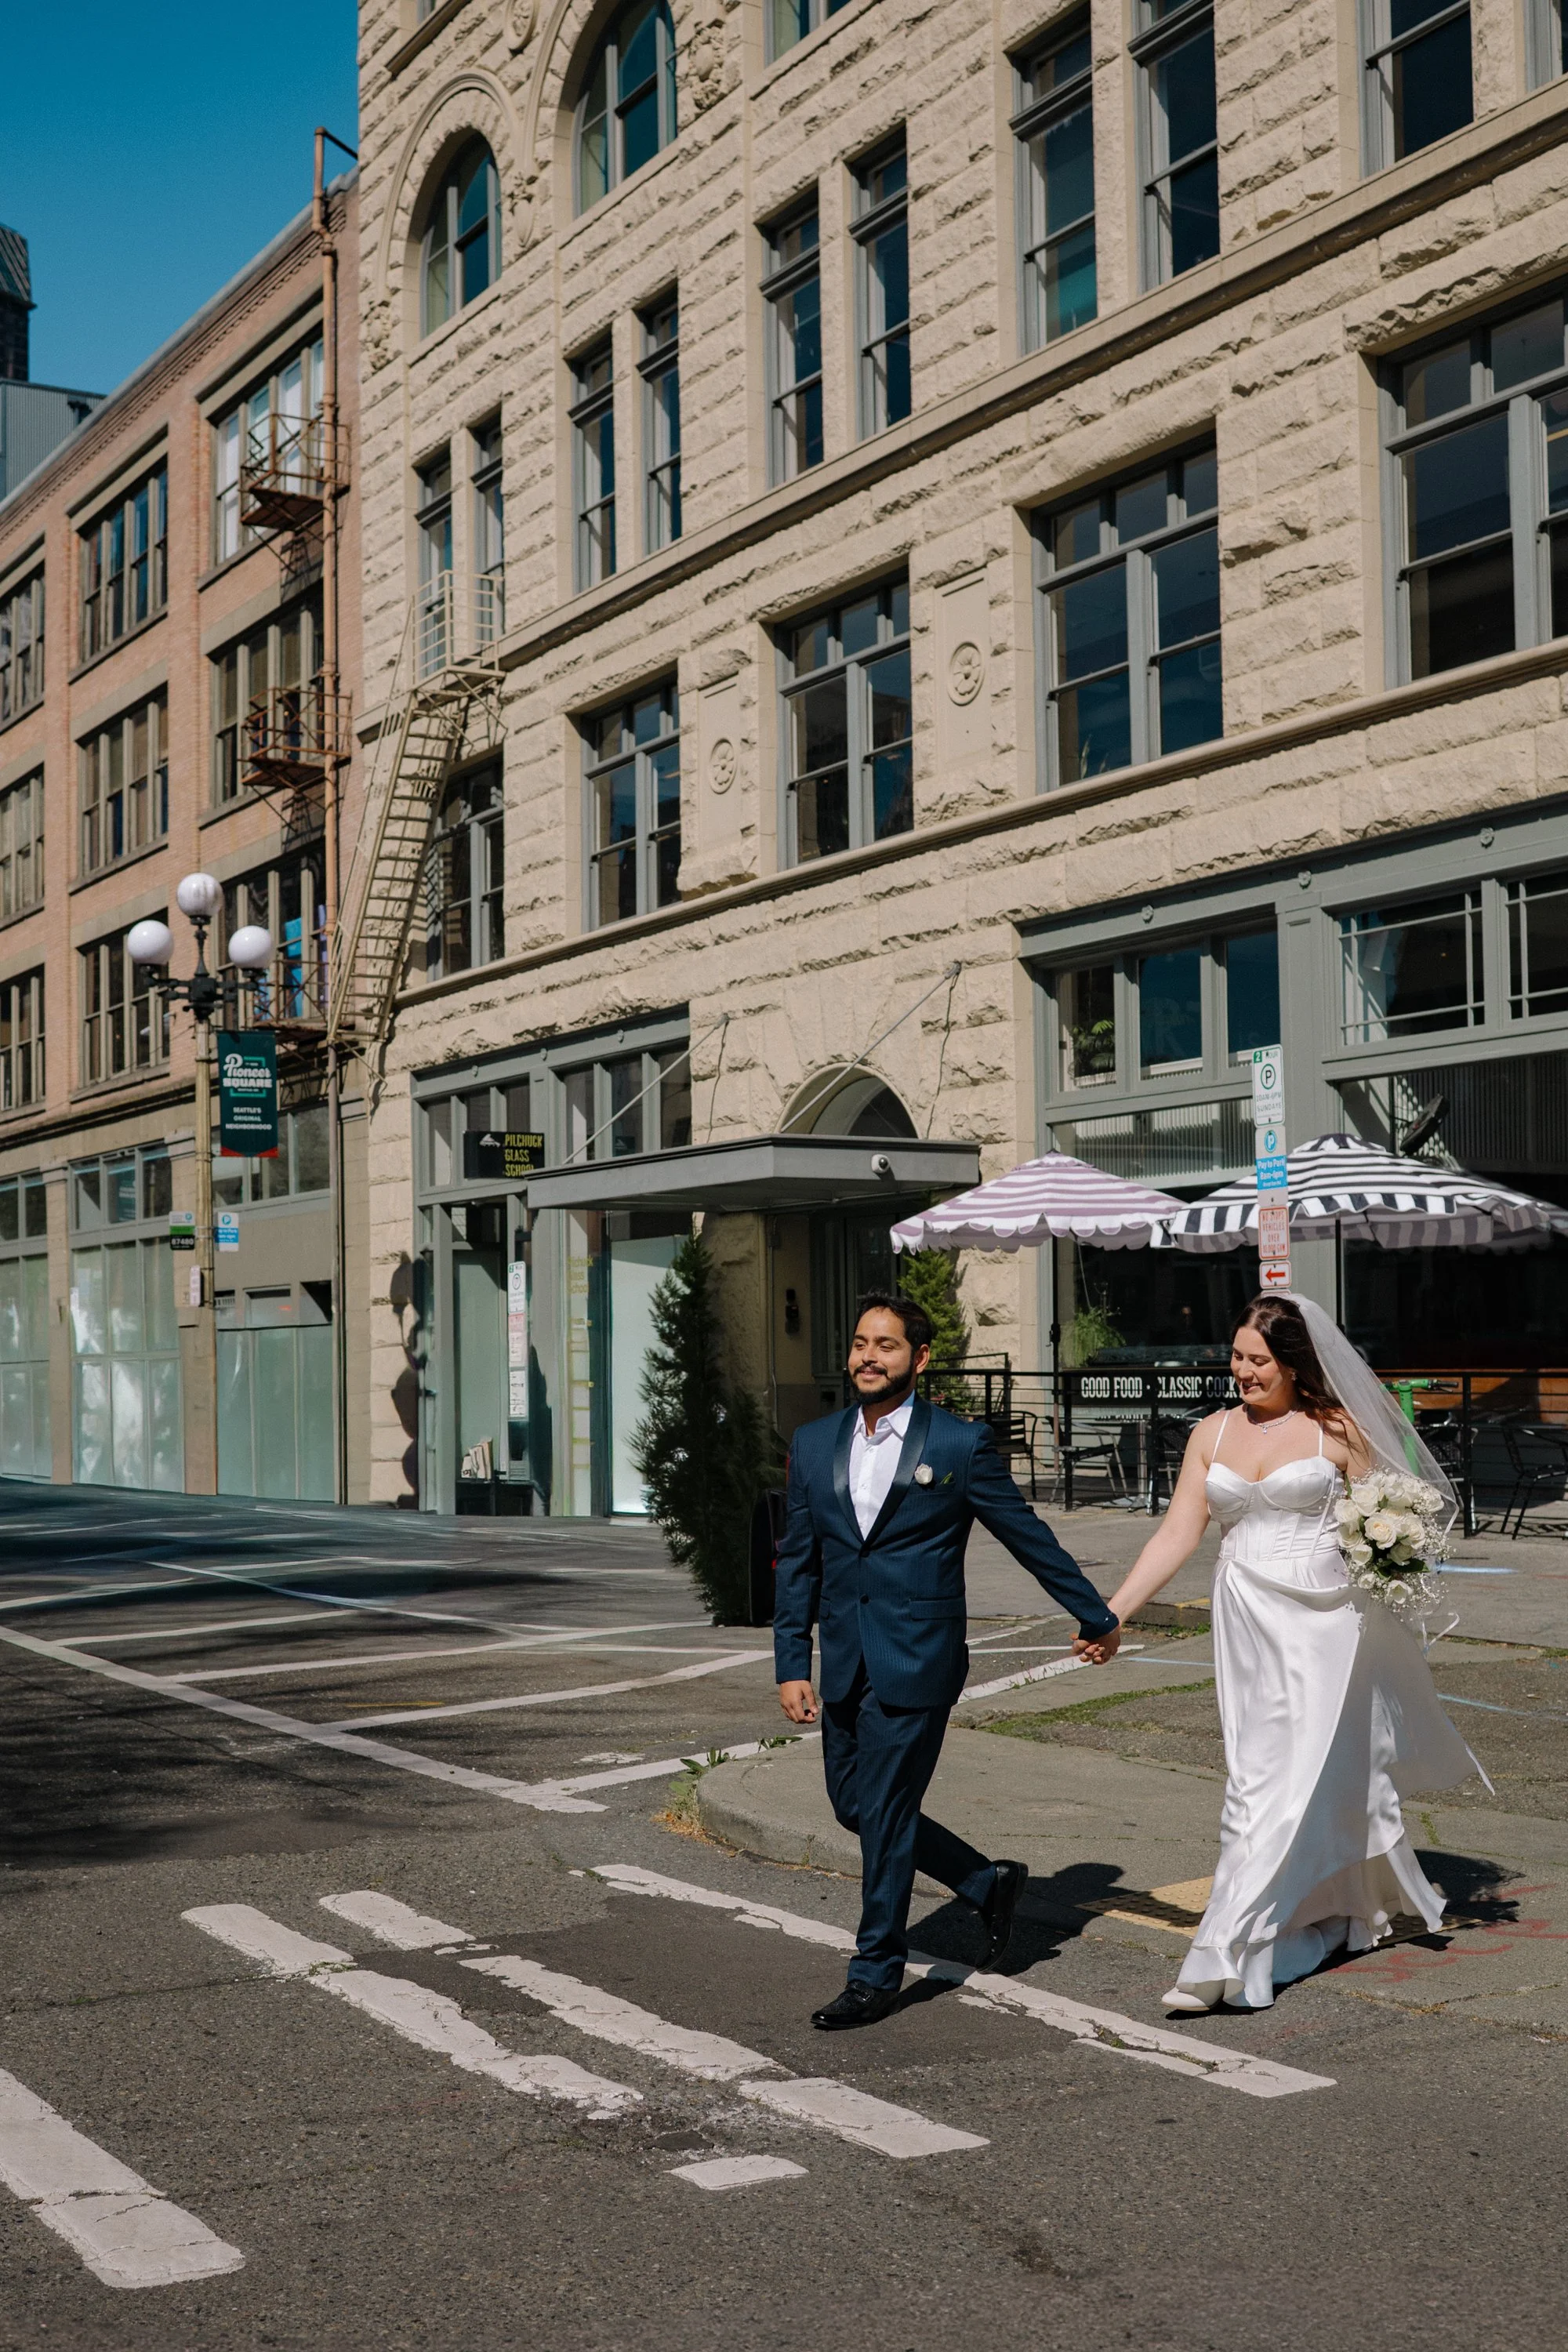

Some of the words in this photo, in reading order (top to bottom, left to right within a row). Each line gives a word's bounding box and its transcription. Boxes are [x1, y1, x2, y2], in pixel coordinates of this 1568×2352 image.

[223, 1053, 271, 1078] Pioneer
[223, 1077, 273, 1088] SQUARE
[505, 1134, 543, 1148] PILCHUCK
[505, 1149, 530, 1162] GLASS
[505, 1163, 535, 1177] SCHOO
[1081, 1377, 1110, 1399] GOOD
[1113, 1377, 1143, 1399] FOOD
